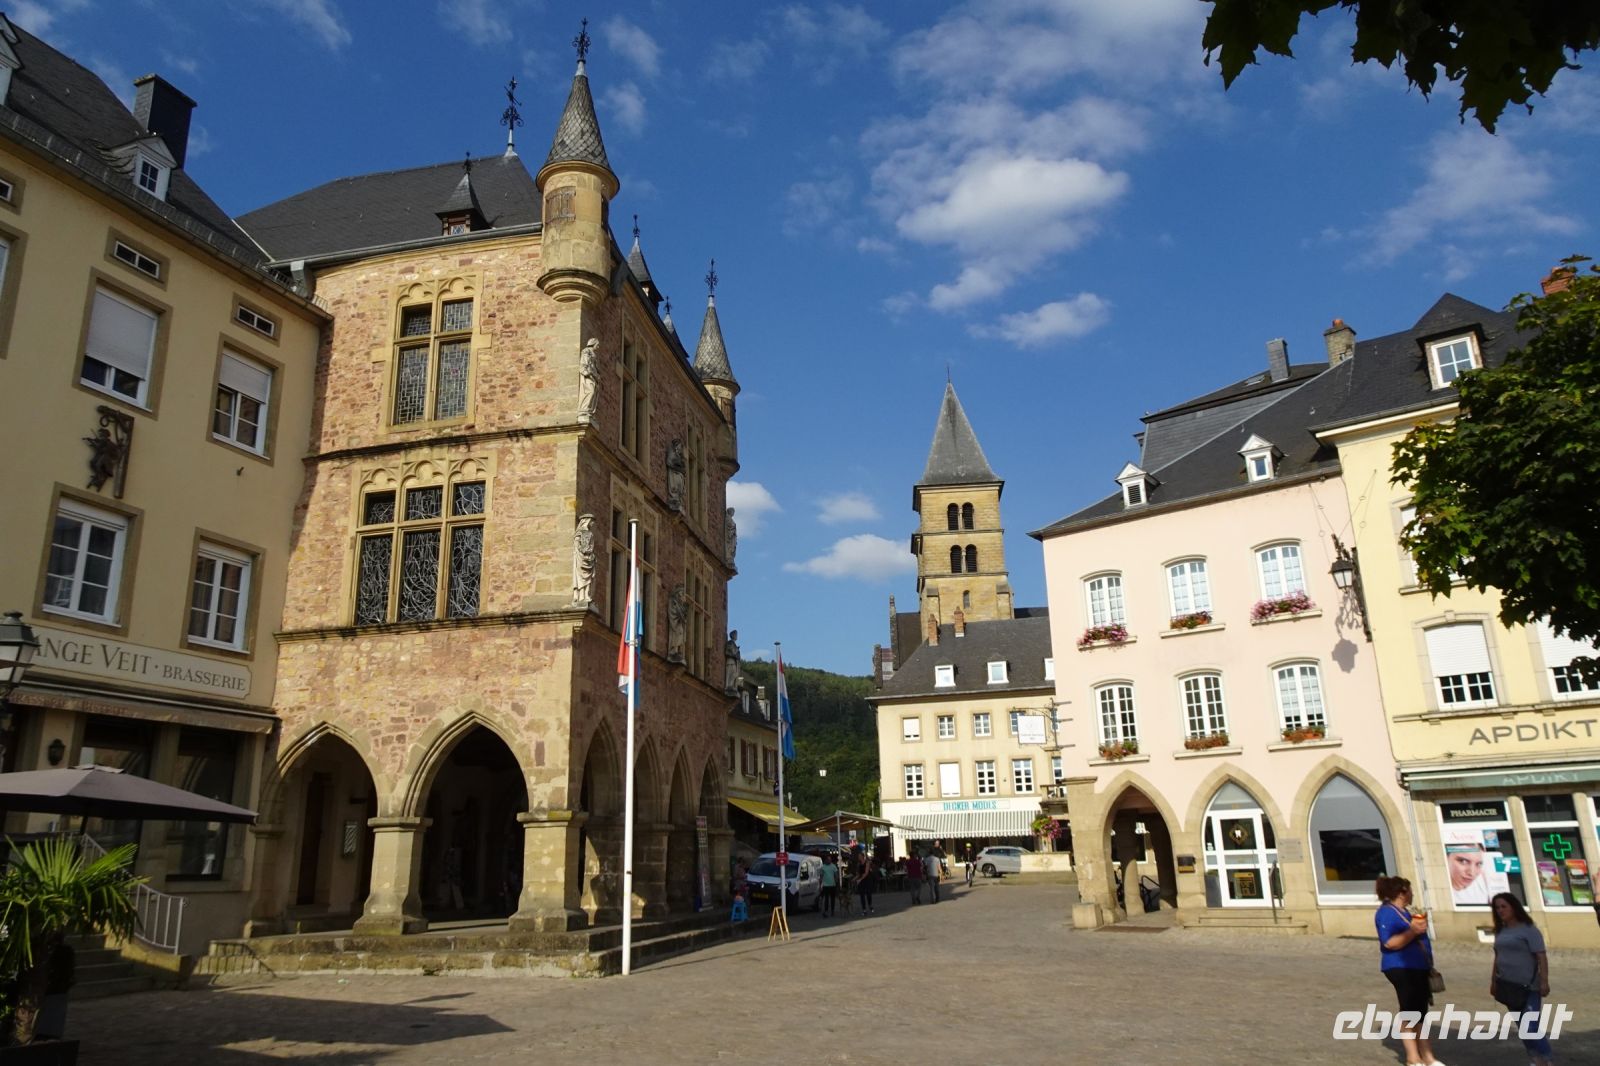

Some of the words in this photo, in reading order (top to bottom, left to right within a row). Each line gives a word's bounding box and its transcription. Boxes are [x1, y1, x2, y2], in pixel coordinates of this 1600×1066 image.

[162, 664, 246, 691] BRASSERIE
[1469, 719, 1597, 746] APDIKT
[1450, 808, 1498, 818] PHARMACIE
